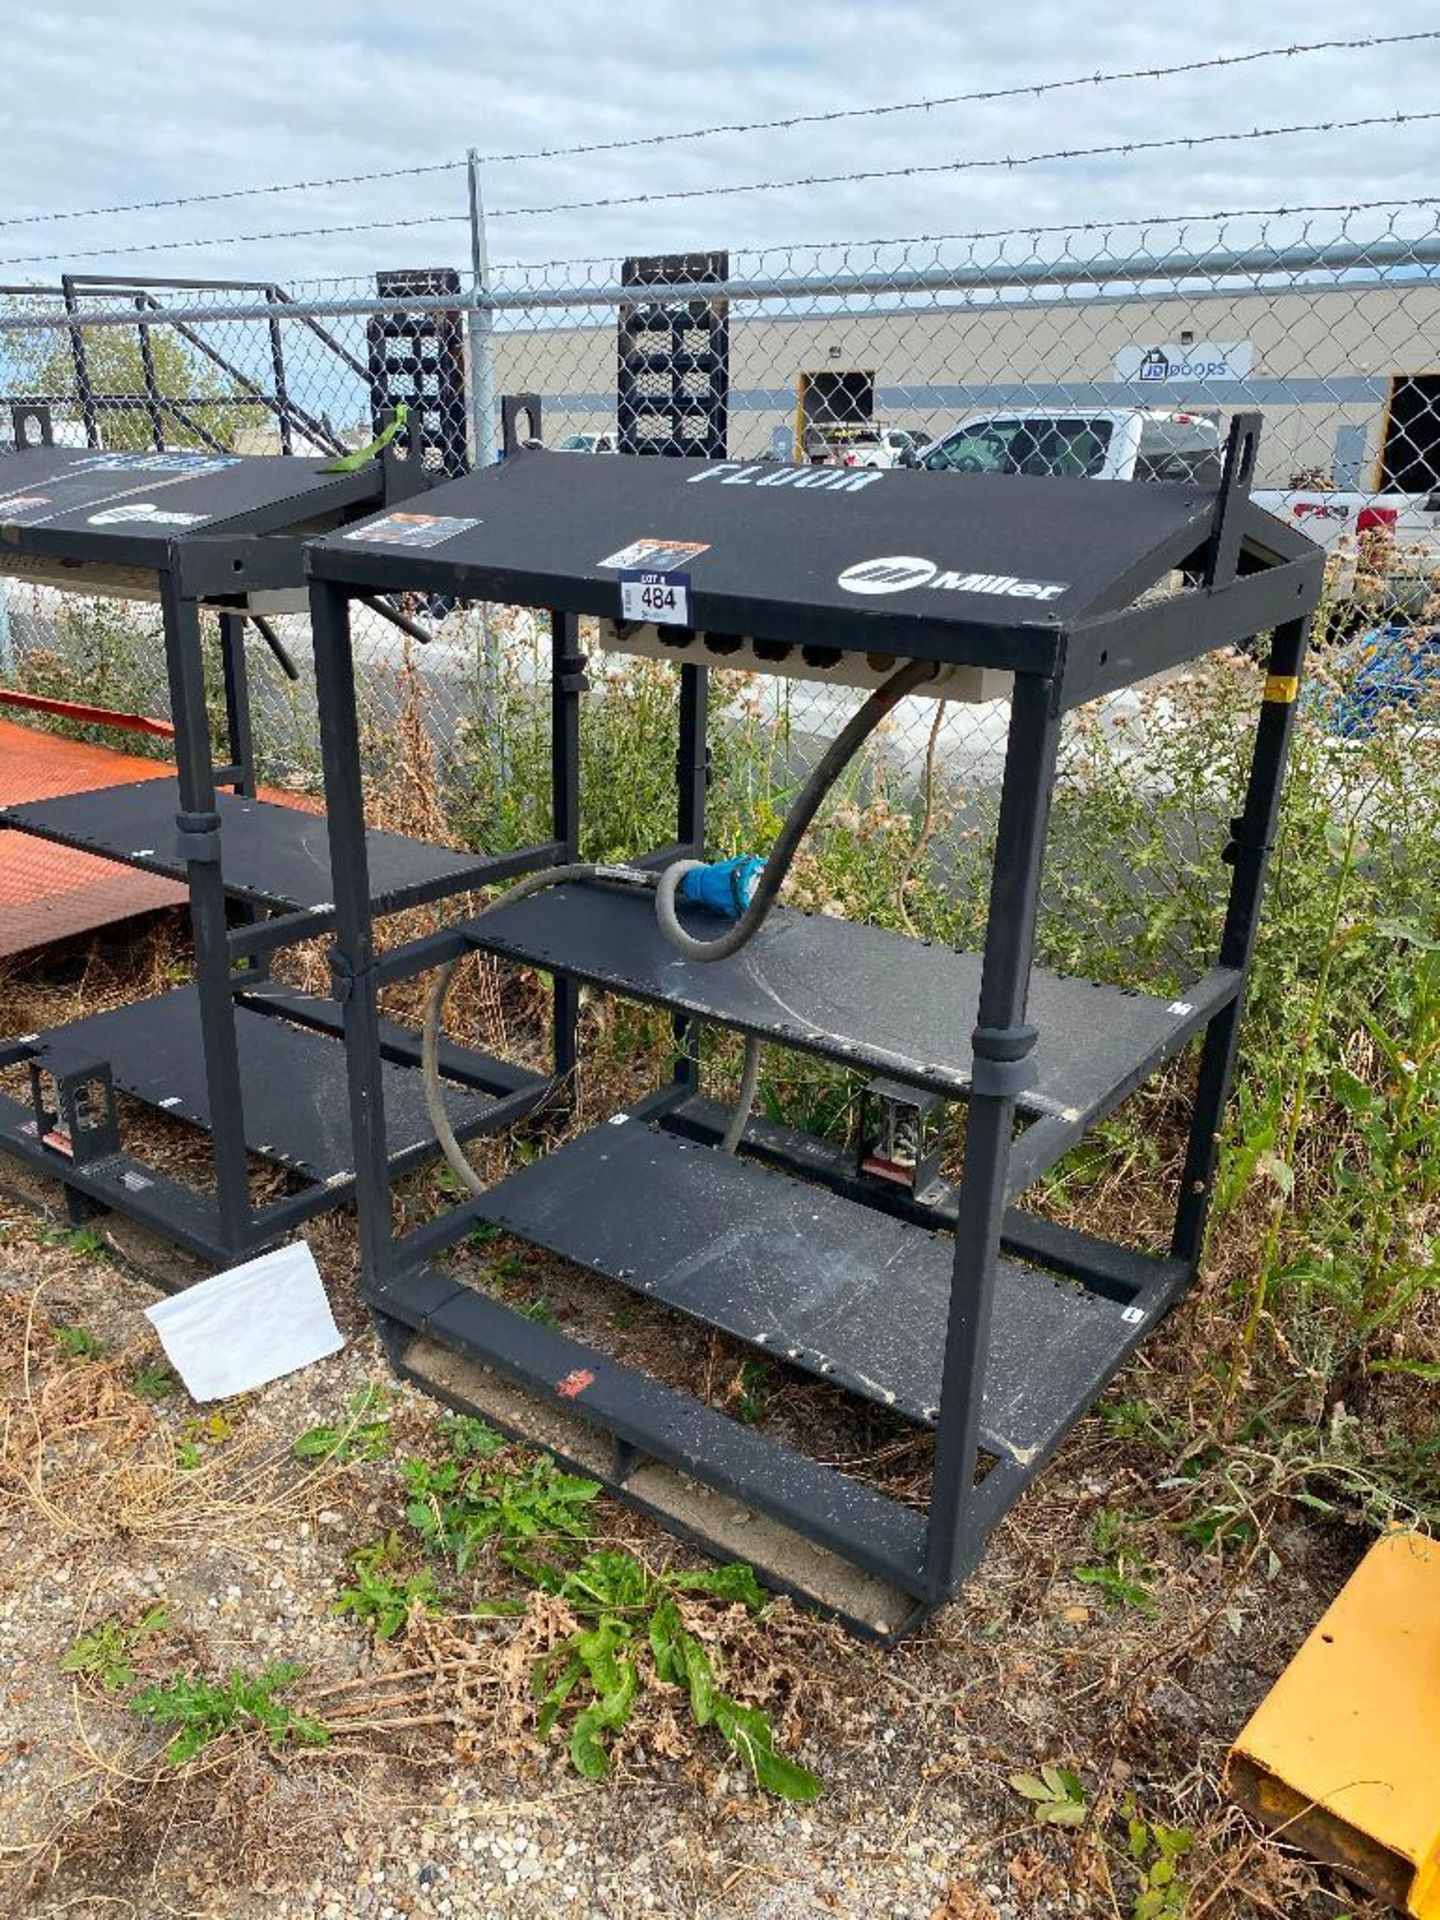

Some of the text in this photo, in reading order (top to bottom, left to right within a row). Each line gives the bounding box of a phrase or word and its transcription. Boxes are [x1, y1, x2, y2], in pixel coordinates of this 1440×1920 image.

[1144, 363, 1227, 377] JD DOORS
[686, 464, 884, 491] FLUOR
[641, 575, 659, 583] LOT
[929, 571, 1066, 600] Miller
[641, 586, 677, 610] 484
